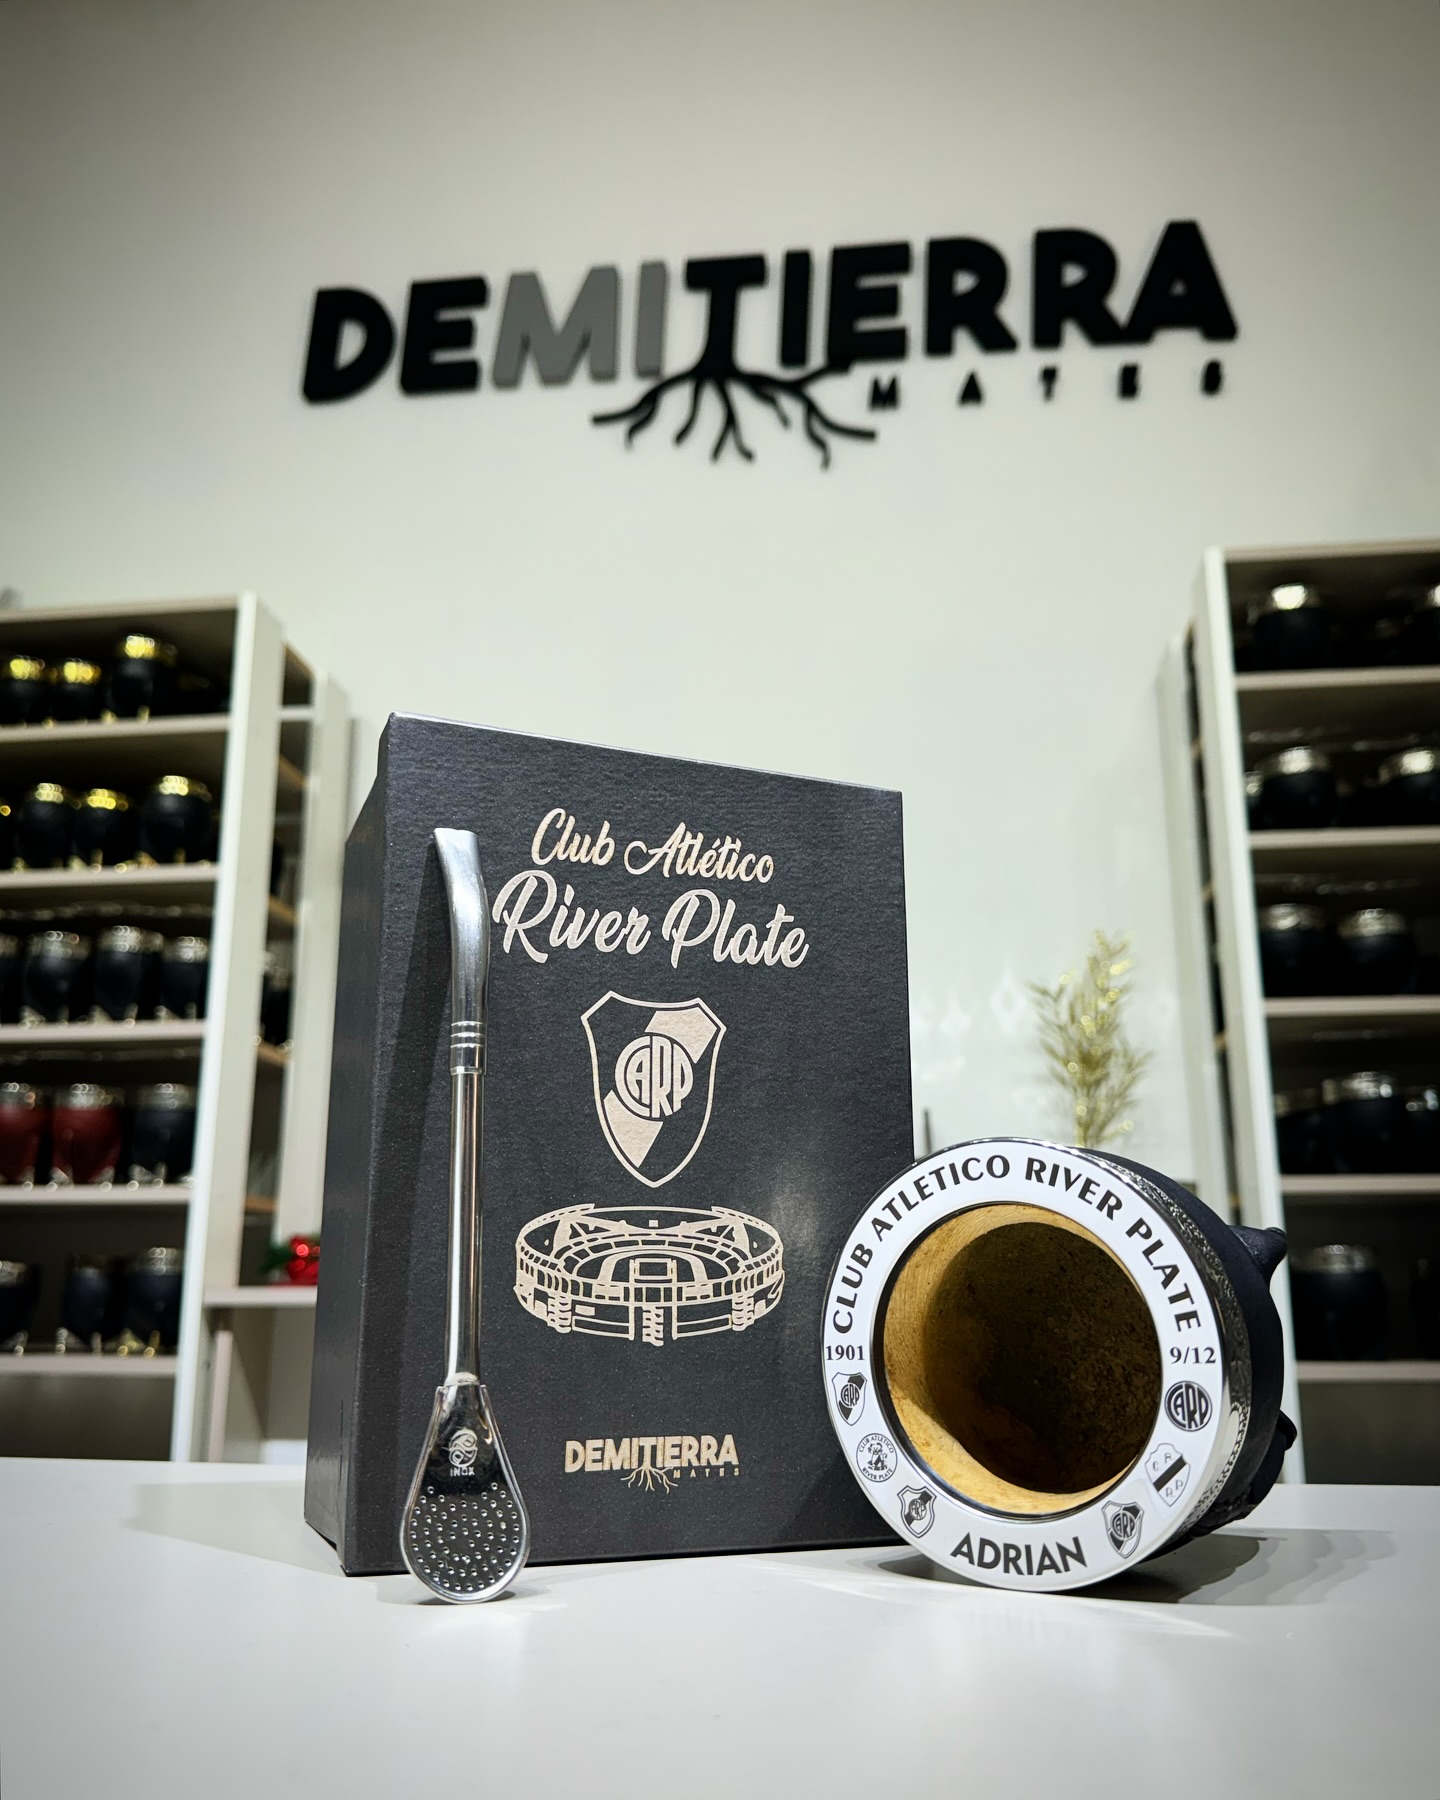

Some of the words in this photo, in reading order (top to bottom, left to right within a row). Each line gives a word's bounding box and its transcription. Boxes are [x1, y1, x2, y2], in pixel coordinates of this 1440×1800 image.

[303, 218, 1240, 404] DEMITIERRA
[531, 808, 616, 865] Club
[624, 822, 774, 883] Atlético
[493, 870, 651, 963] River
[662, 889, 809, 968] Plate
[832, 1243, 874, 1333] CLUB
[872, 1154, 1010, 1242] ATLETICO
[1024, 1157, 1123, 1220] RIVER
[1126, 1217, 1201, 1332] PLATE
[826, 1345, 865, 1361] 1901
[1170, 1347, 1216, 1364] 9/12
[450, 1467, 475, 1476] INOX
[564, 1434, 740, 1473] DEMITIERRA
[673, 1468, 740, 1478] MATES
[950, 1532, 1087, 1575] ADRIAN
